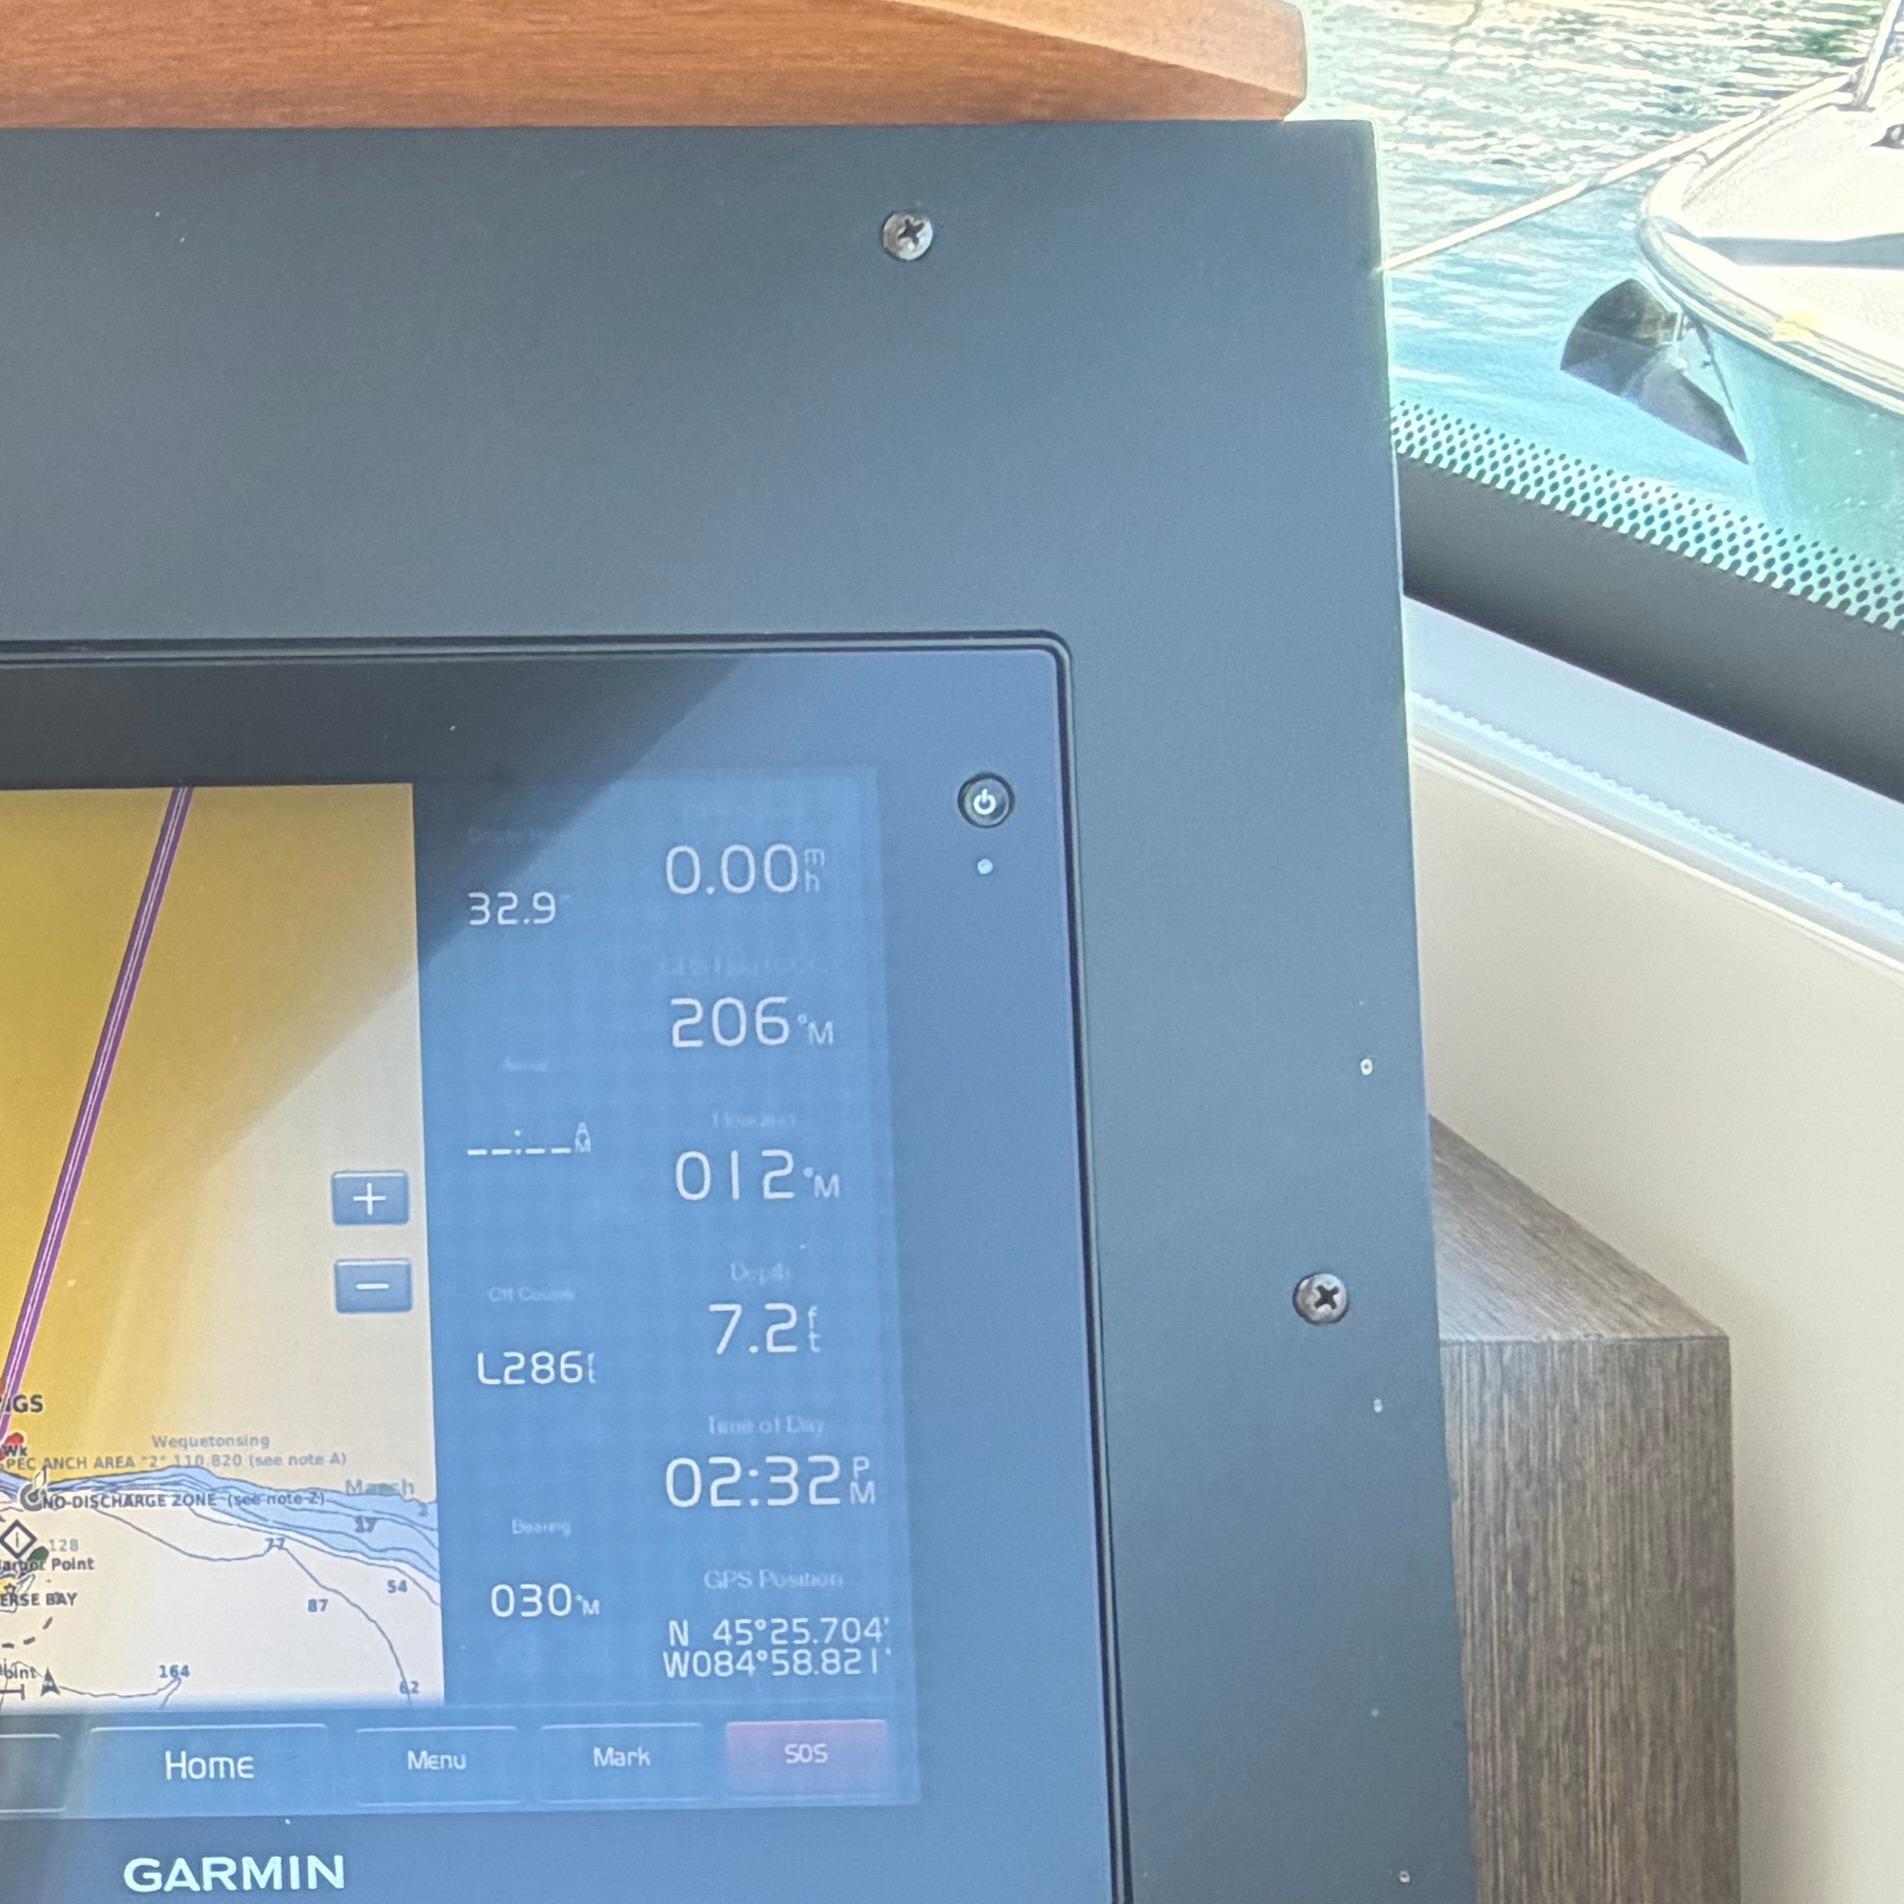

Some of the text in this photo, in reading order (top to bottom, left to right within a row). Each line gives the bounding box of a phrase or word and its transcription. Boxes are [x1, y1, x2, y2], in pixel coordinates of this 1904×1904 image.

[666, 843, 799, 895] 0.00
[709, 1302, 798, 1355] 7.2
[152, 1435, 271, 1450] Wequetonsing
[43, 1457, 88, 1470] ANCH
[94, 1456, 135, 1469] AREA
[249, 1454, 282, 1468] (see
[288, 1453, 324, 1467] note
[665, 1455, 841, 1508] 02:32
[172, 1494, 217, 1508] ZONE
[51, 1557, 95, 1571] Point
[704, 1570, 844, 1591] GPS Position
[45, 1592, 78, 1607] BAY
[668, 1619, 689, 1647] N
[159, 1664, 191, 1678] 164
[408, 1750, 466, 1770] Menu
[594, 1746, 652, 1769] Mark
[784, 1743, 829, 1764] SOS
[165, 1751, 255, 1780] Home
[123, 1855, 345, 1894] GARMIN
